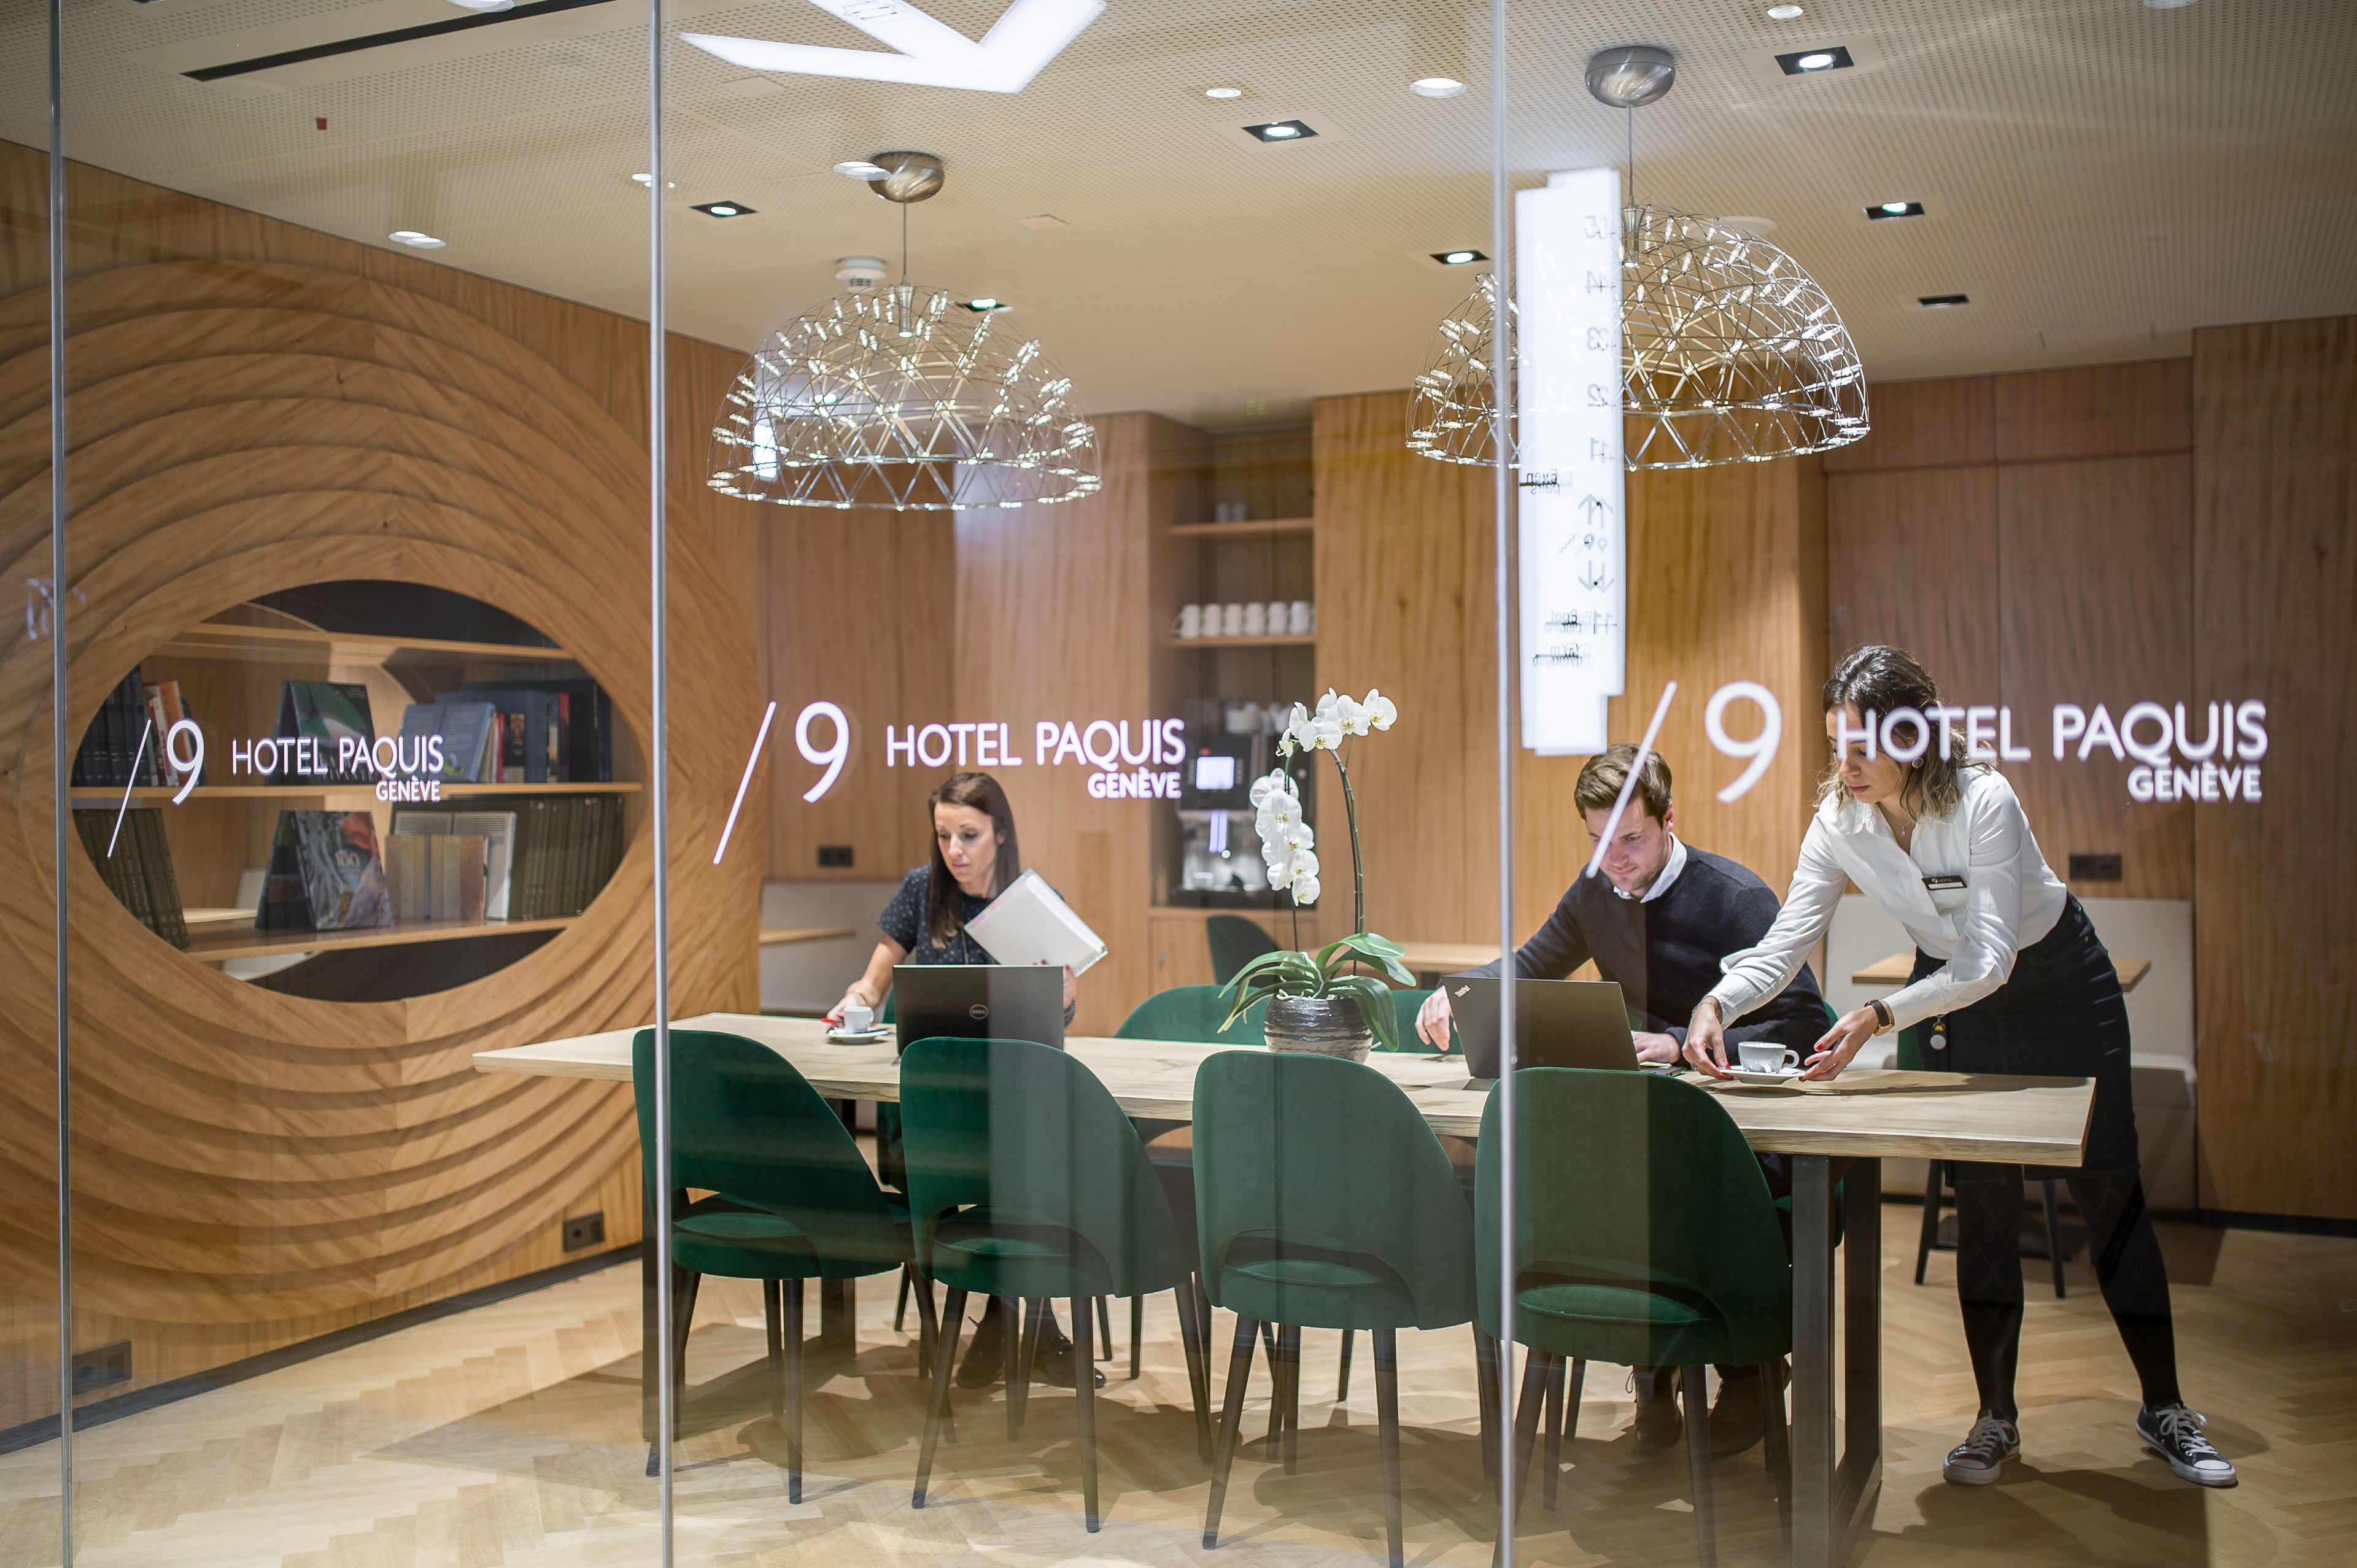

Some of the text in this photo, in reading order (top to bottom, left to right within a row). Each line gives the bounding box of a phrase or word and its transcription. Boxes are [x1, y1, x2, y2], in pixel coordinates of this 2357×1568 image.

[886, 722, 1023, 768] HOTEL
[1035, 718, 1186, 773] PAQUIS
[1836, 706, 2032, 762] HOTEL
[2053, 700, 2268, 765] PAQUIS
[232, 738, 329, 774] HOTEL
[338, 735, 444, 779] PAQUIS
[375, 774, 441, 802] GENÈVE
[1086, 765, 1182, 799] GENÈVE
[2127, 762, 2262, 801] GENÈVE
